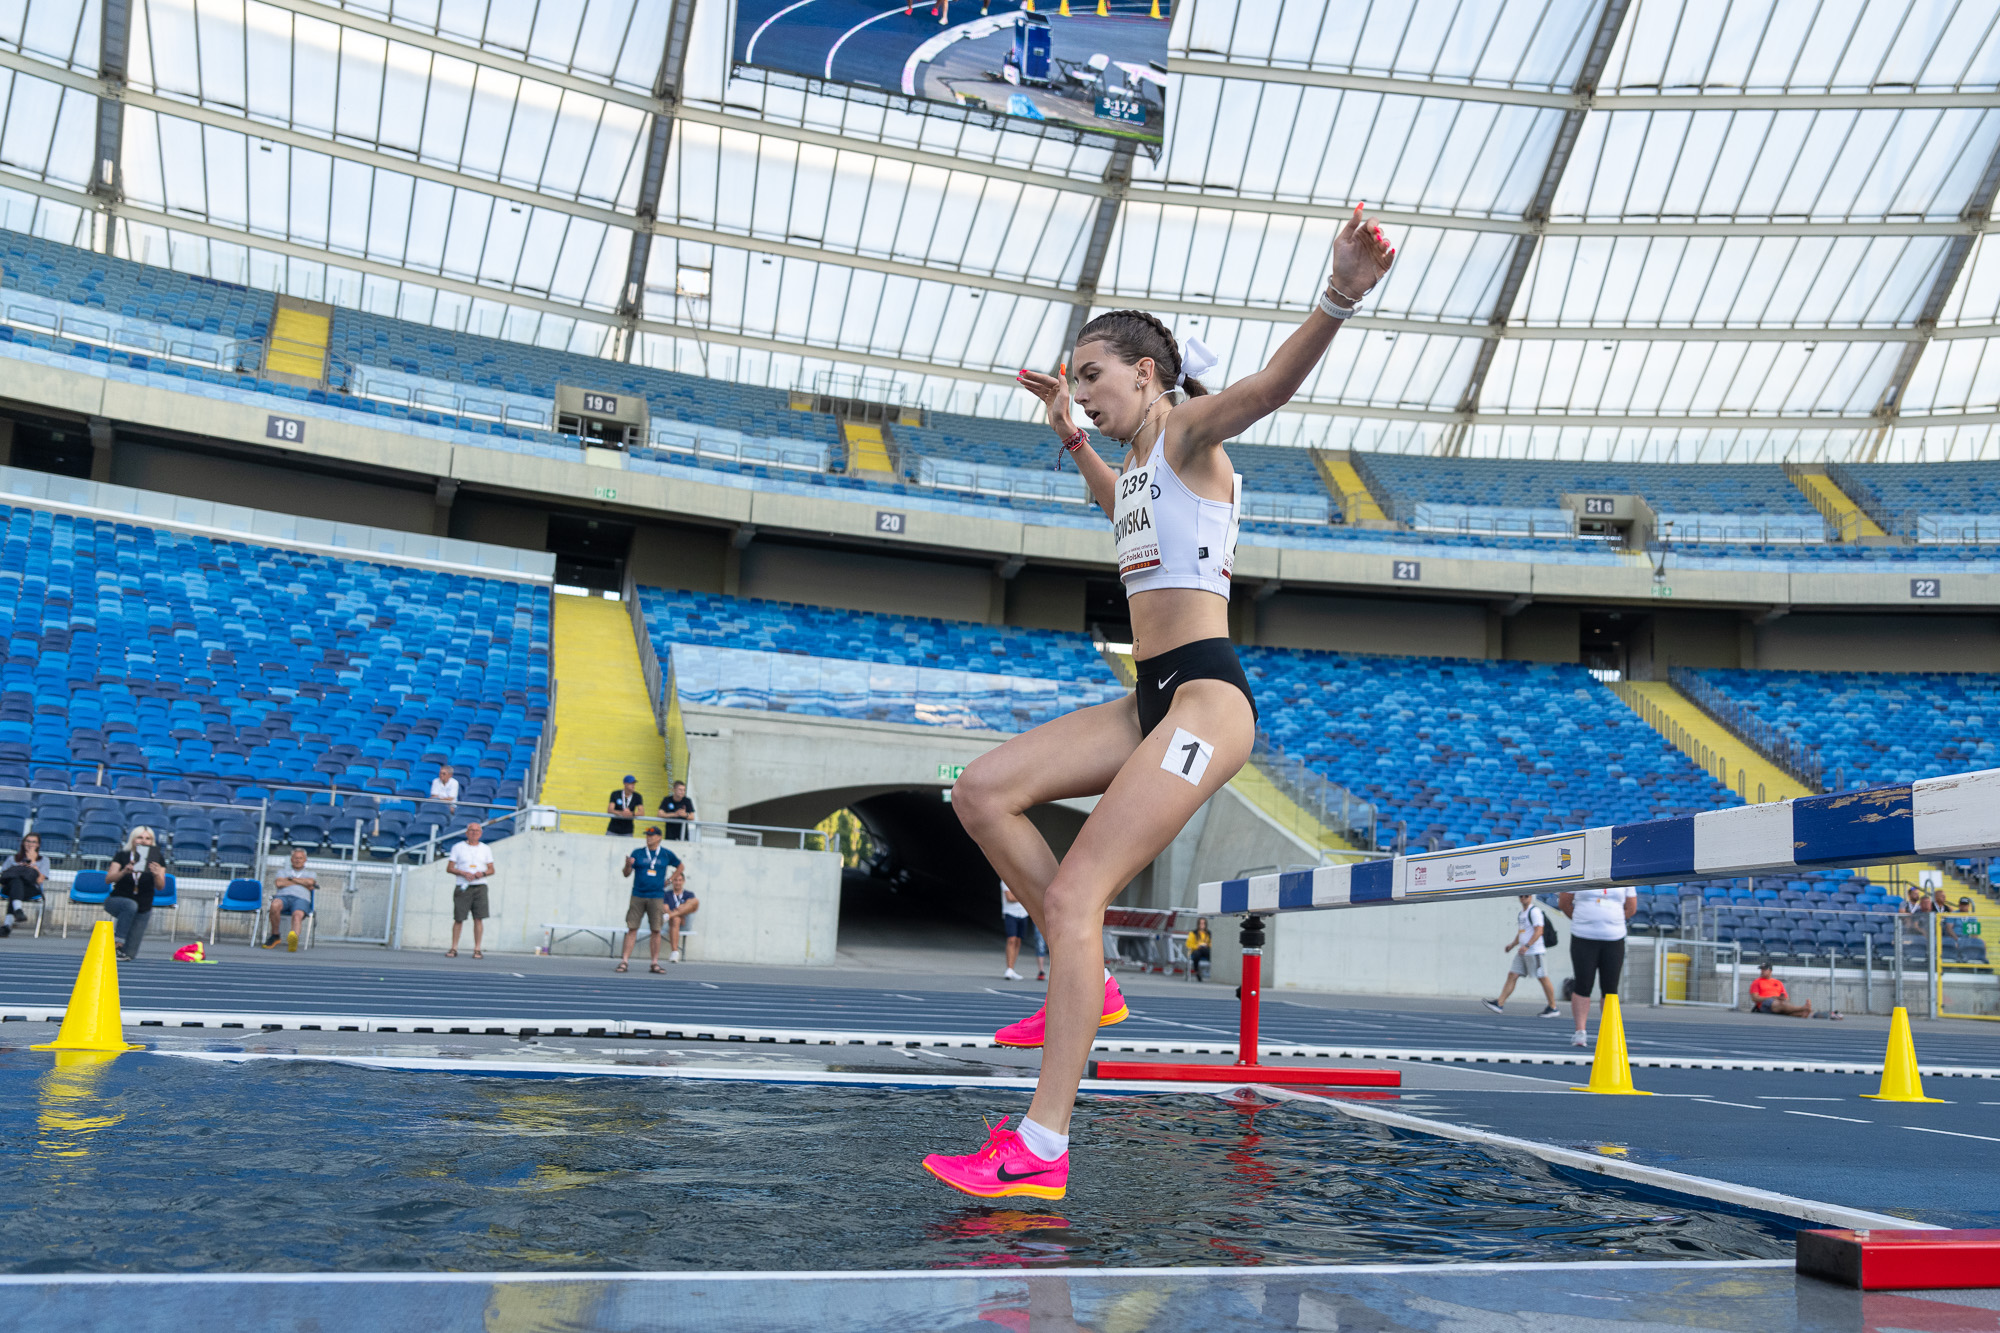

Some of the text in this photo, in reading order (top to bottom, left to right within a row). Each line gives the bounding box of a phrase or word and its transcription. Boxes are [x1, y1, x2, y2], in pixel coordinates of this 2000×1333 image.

[1102, 97, 1139, 115] 3:17.8
[586, 395, 615, 413] 19 G
[275, 419, 298, 439] 19
[1122, 472, 1148, 500] 239
[1587, 499, 1602, 513] 21
[880, 513, 900, 531] 20
[1145, 547, 1159, 558] U18
[1397, 562, 1416, 579] 21
[1916, 580, 1935, 597] 22
[1181, 741, 1200, 775] 1
[1966, 923, 1978, 934] 31
